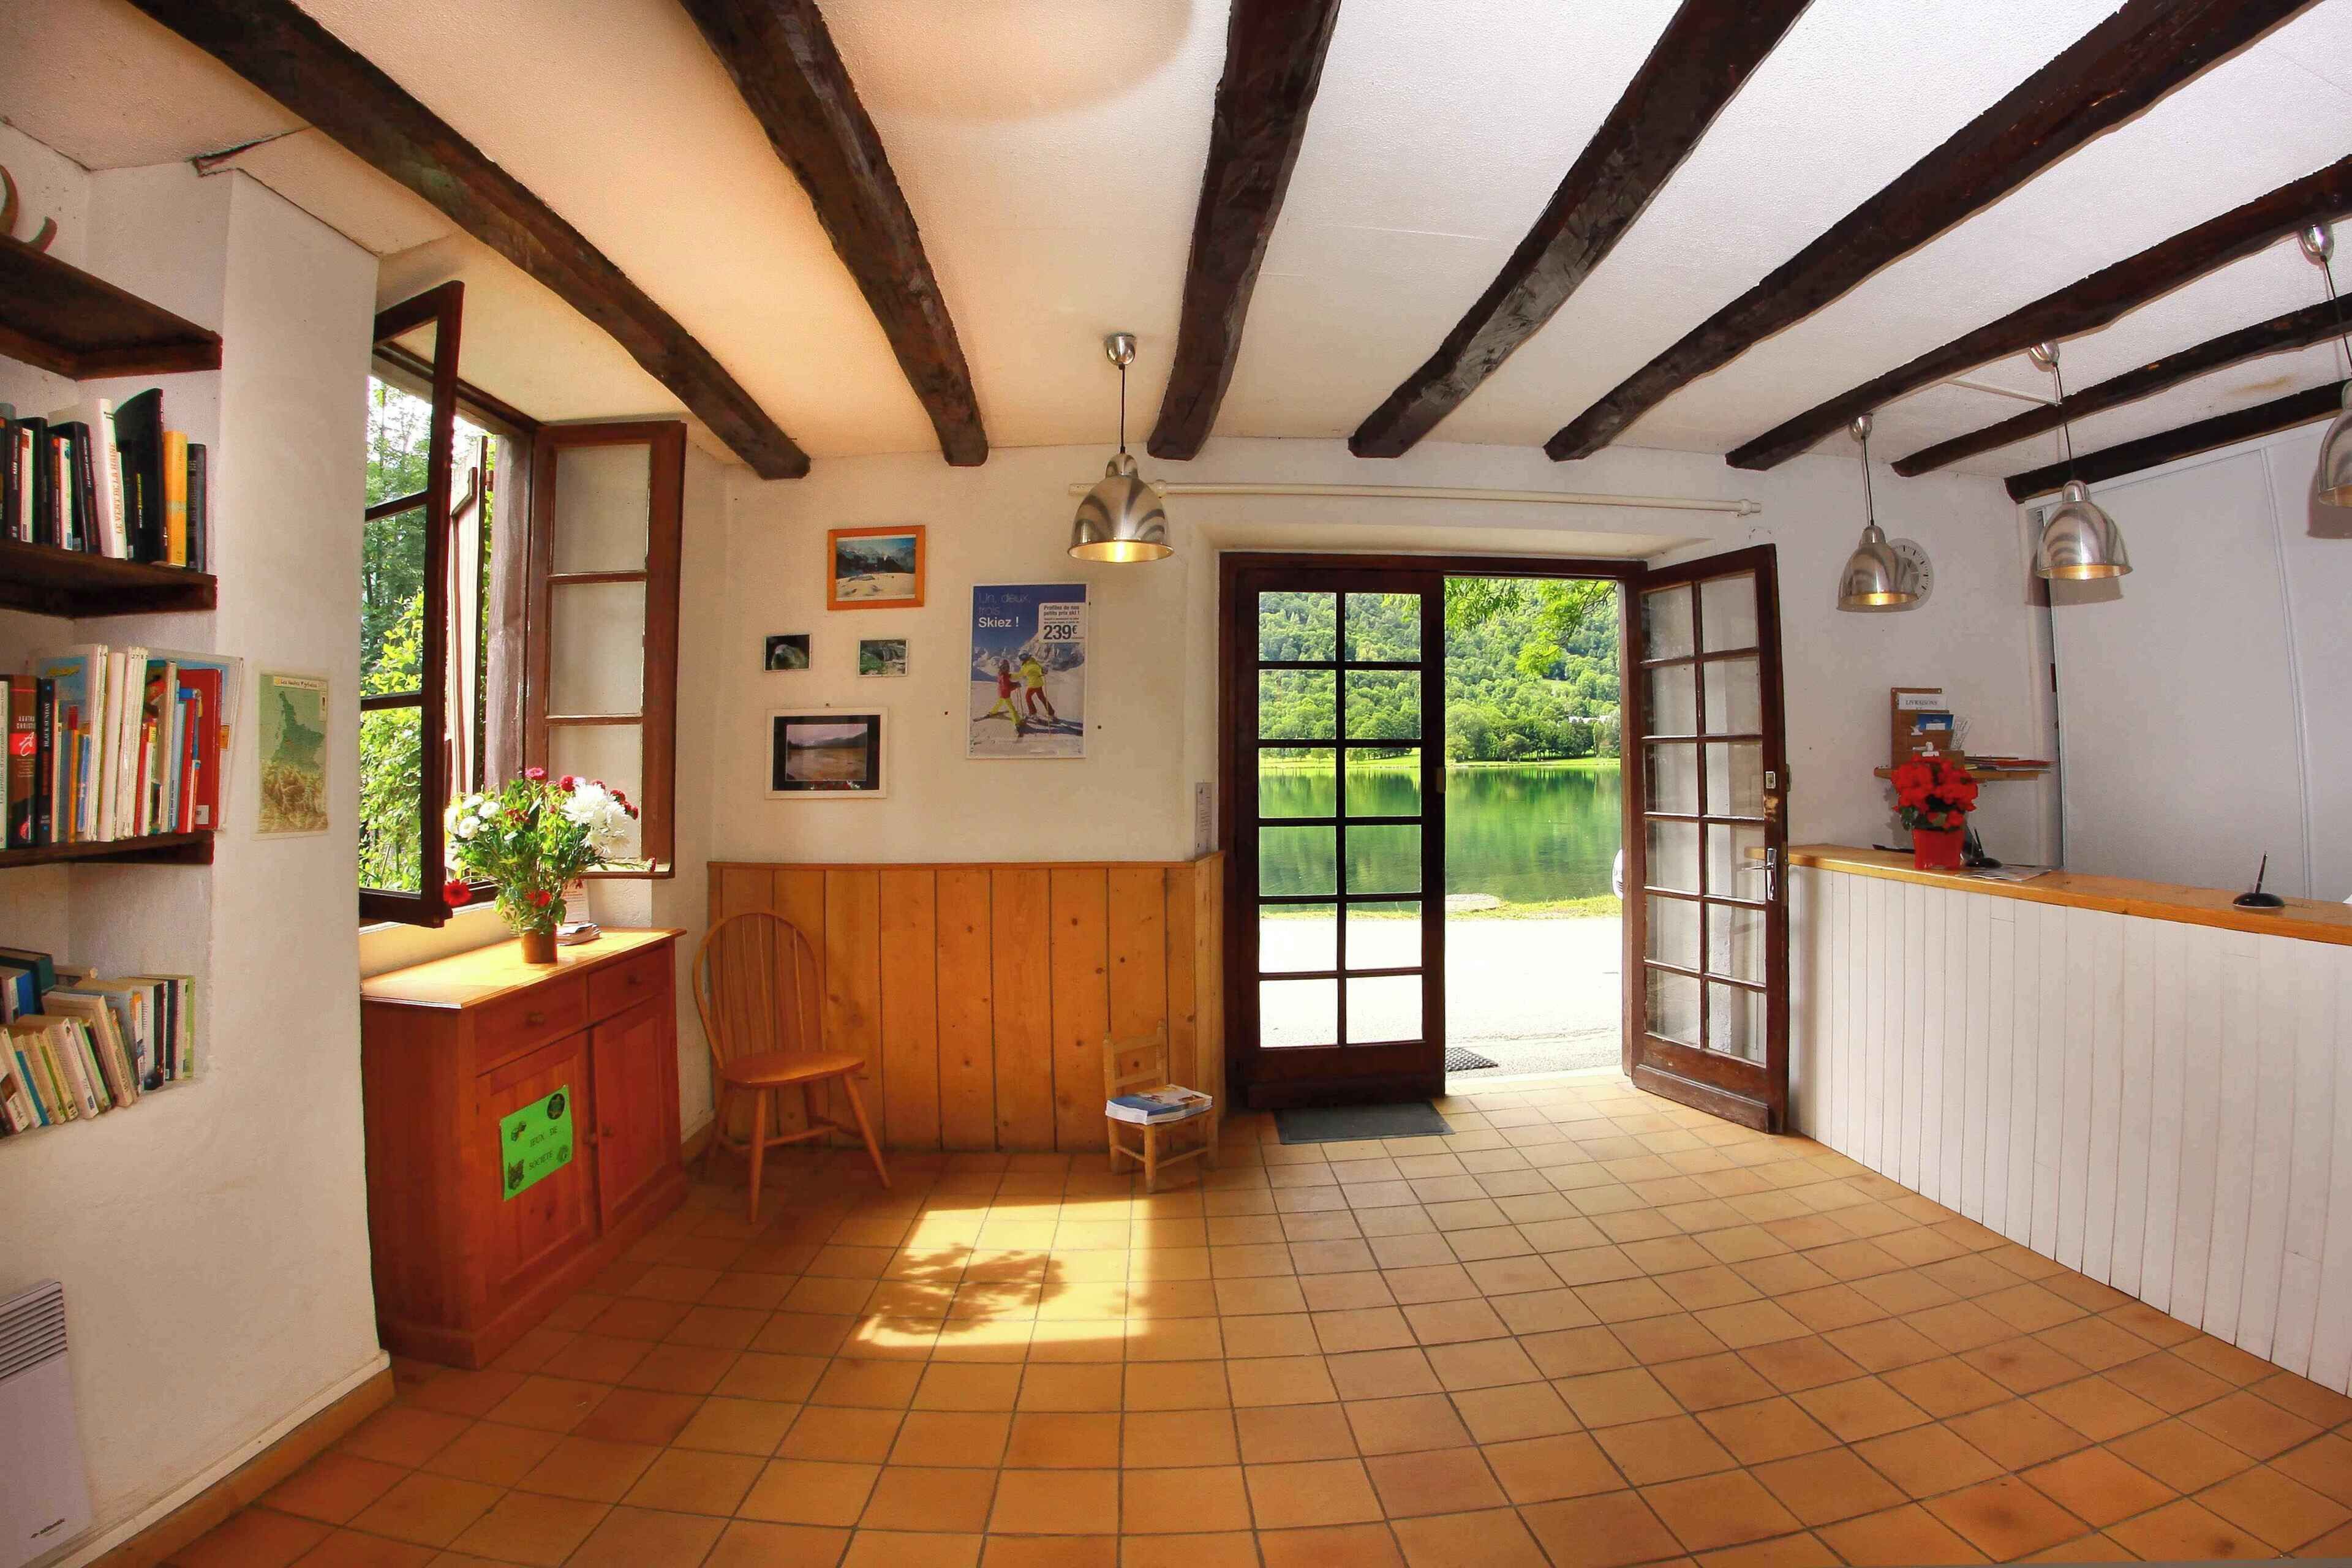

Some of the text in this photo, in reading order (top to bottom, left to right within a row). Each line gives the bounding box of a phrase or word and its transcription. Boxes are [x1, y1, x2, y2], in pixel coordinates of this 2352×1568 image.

[109, 443, 118, 470] HAINE
[111, 471, 119, 483] LA
[113, 485, 120, 497] DE
[978, 616, 1019, 628] Skiez !
[529, 1126, 558, 1147] JEUX DE
